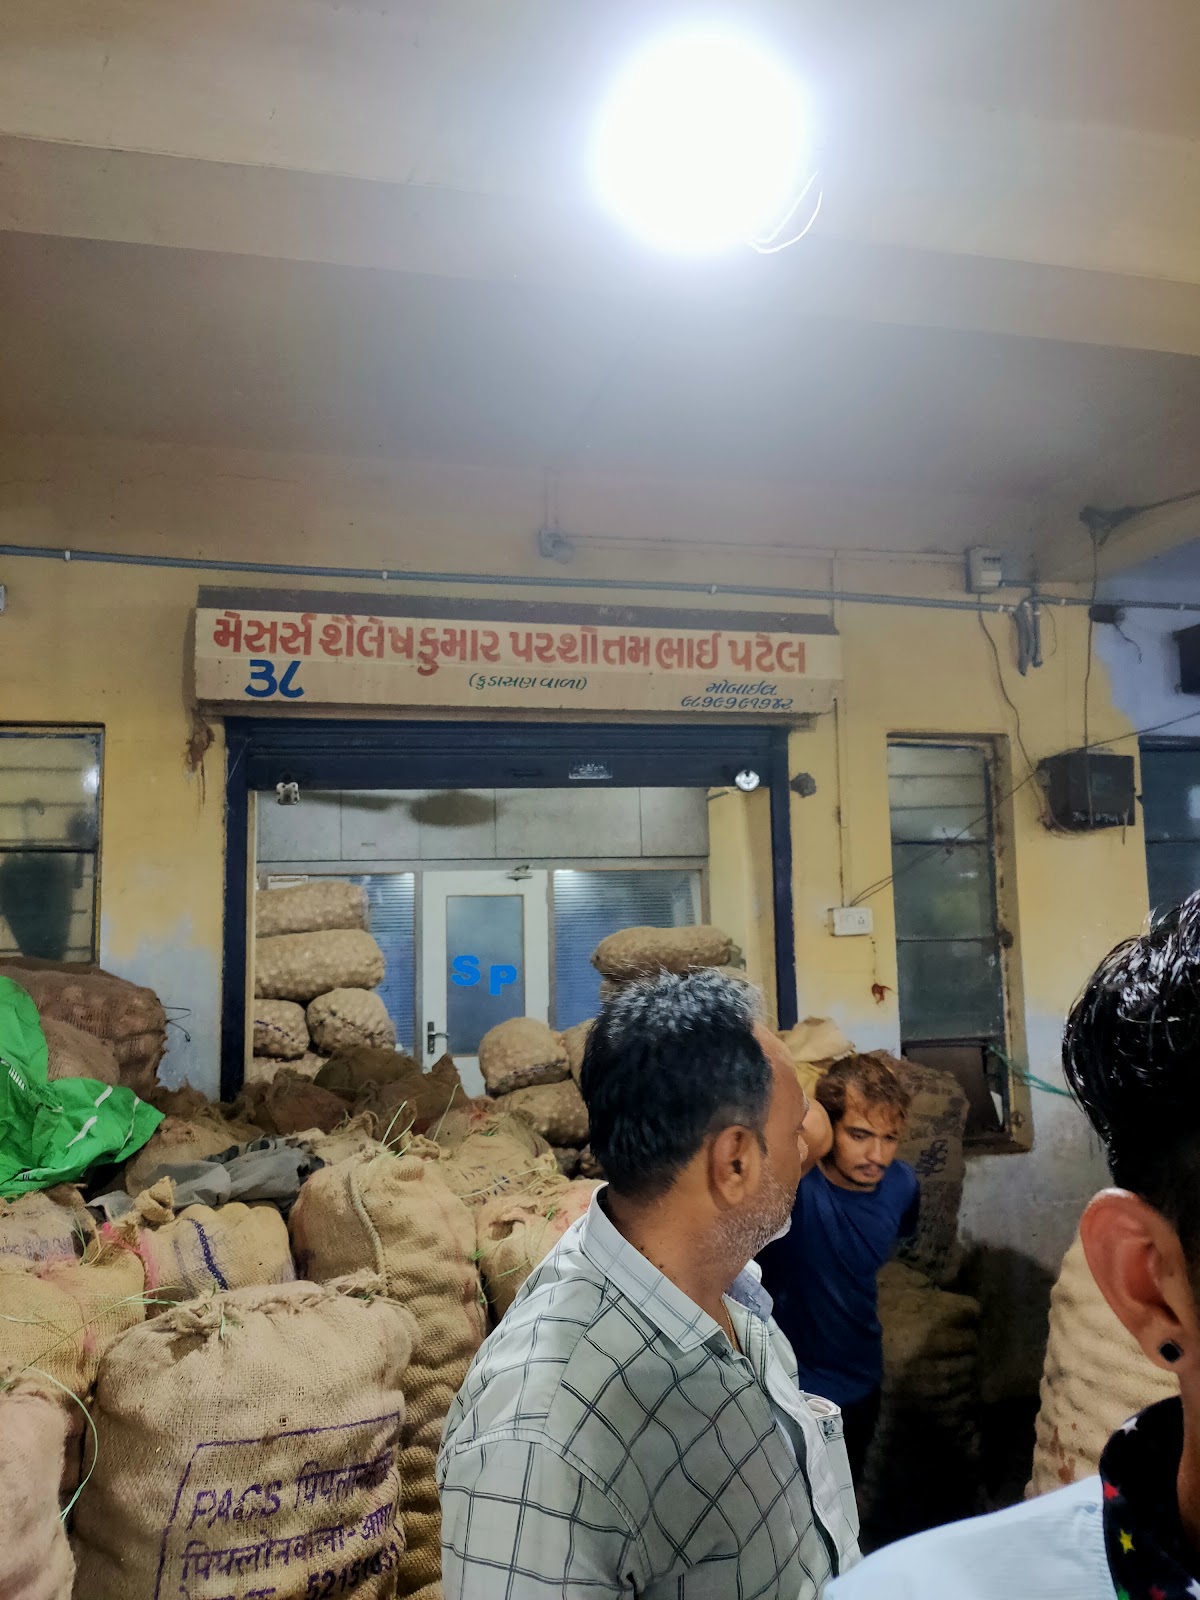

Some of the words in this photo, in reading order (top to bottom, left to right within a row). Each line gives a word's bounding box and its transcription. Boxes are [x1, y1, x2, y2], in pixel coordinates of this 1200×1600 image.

[213, 611, 318, 656] મેસર્સ
[728, 632, 806, 674] પટેલ
[245, 659, 305, 698] ૩૮
